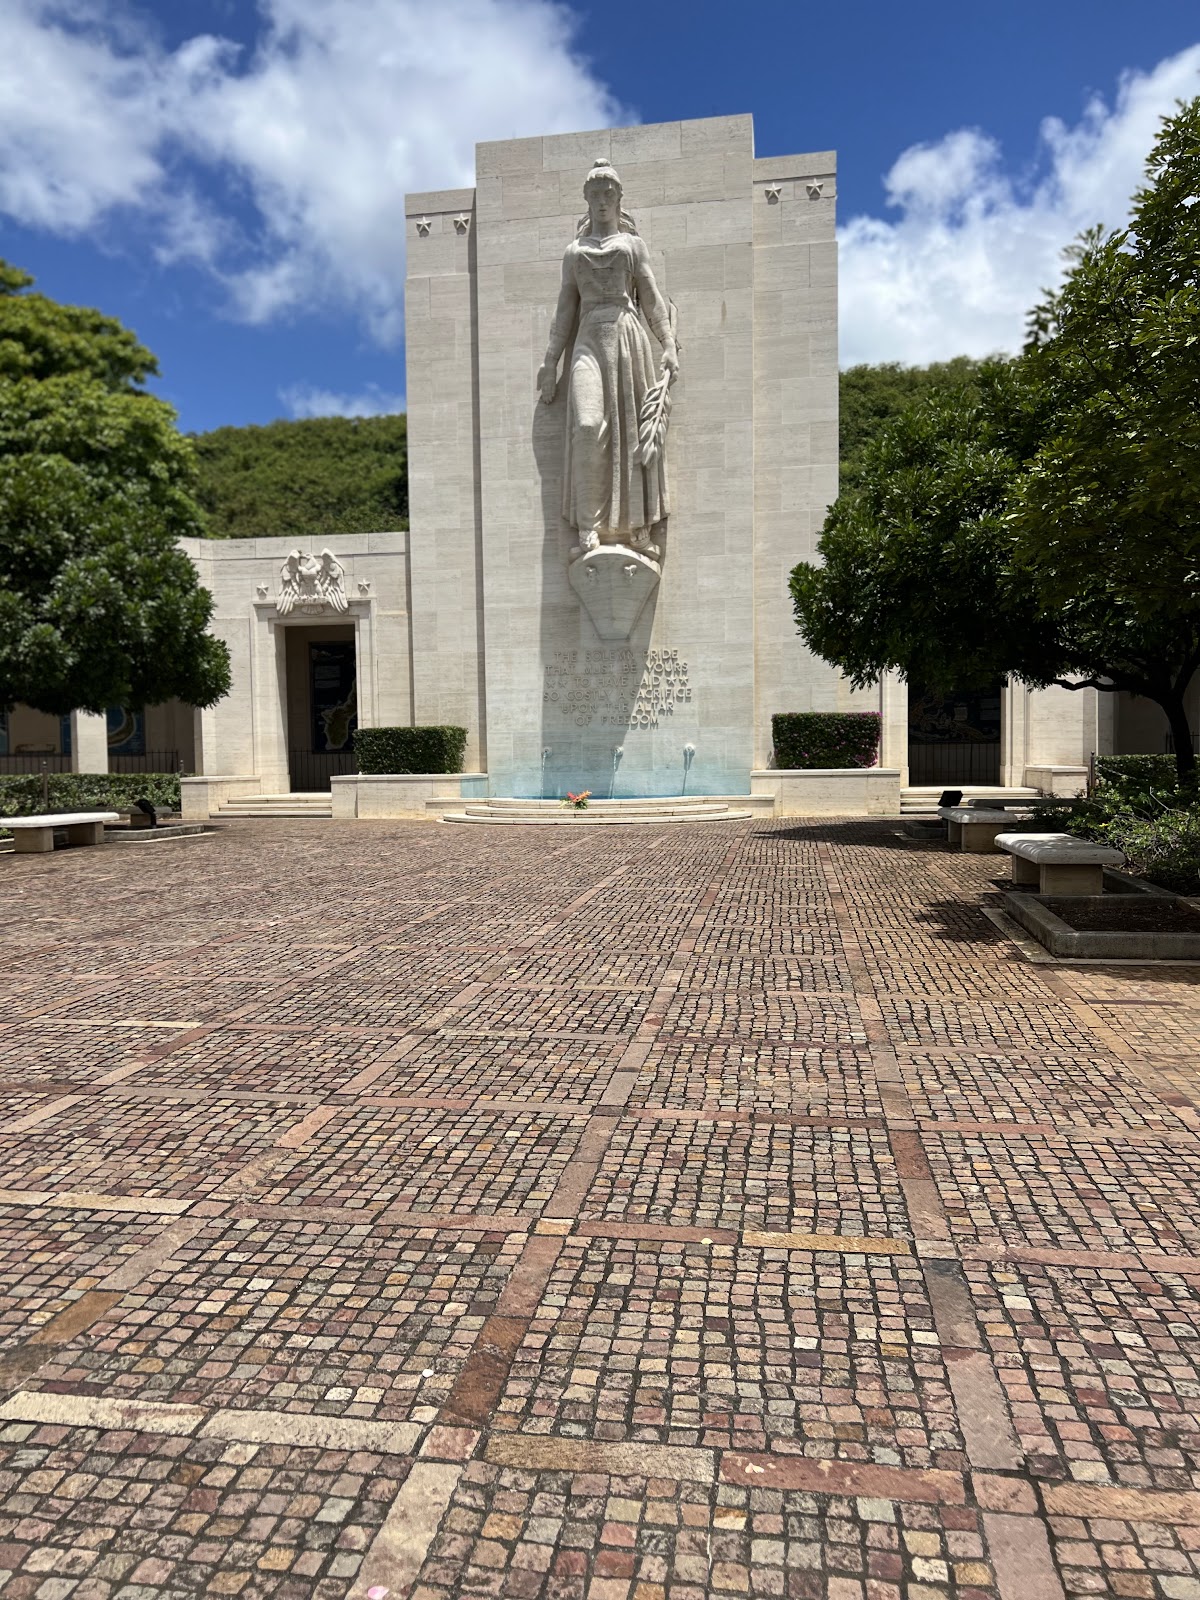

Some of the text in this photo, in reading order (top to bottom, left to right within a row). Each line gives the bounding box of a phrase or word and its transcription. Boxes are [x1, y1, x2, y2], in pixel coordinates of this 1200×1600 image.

[555, 650, 678, 662] THE SOLEMN PRIDE
[545, 662, 688, 675] THAT MUST BE YOURS
[575, 676, 660, 688] TO HAVE LAID
[543, 689, 692, 701] SO COSTLY A SACRIFICE
[561, 702, 674, 714] UPON THE ALTAR
[575, 714, 659, 726] OF FREEDOM
